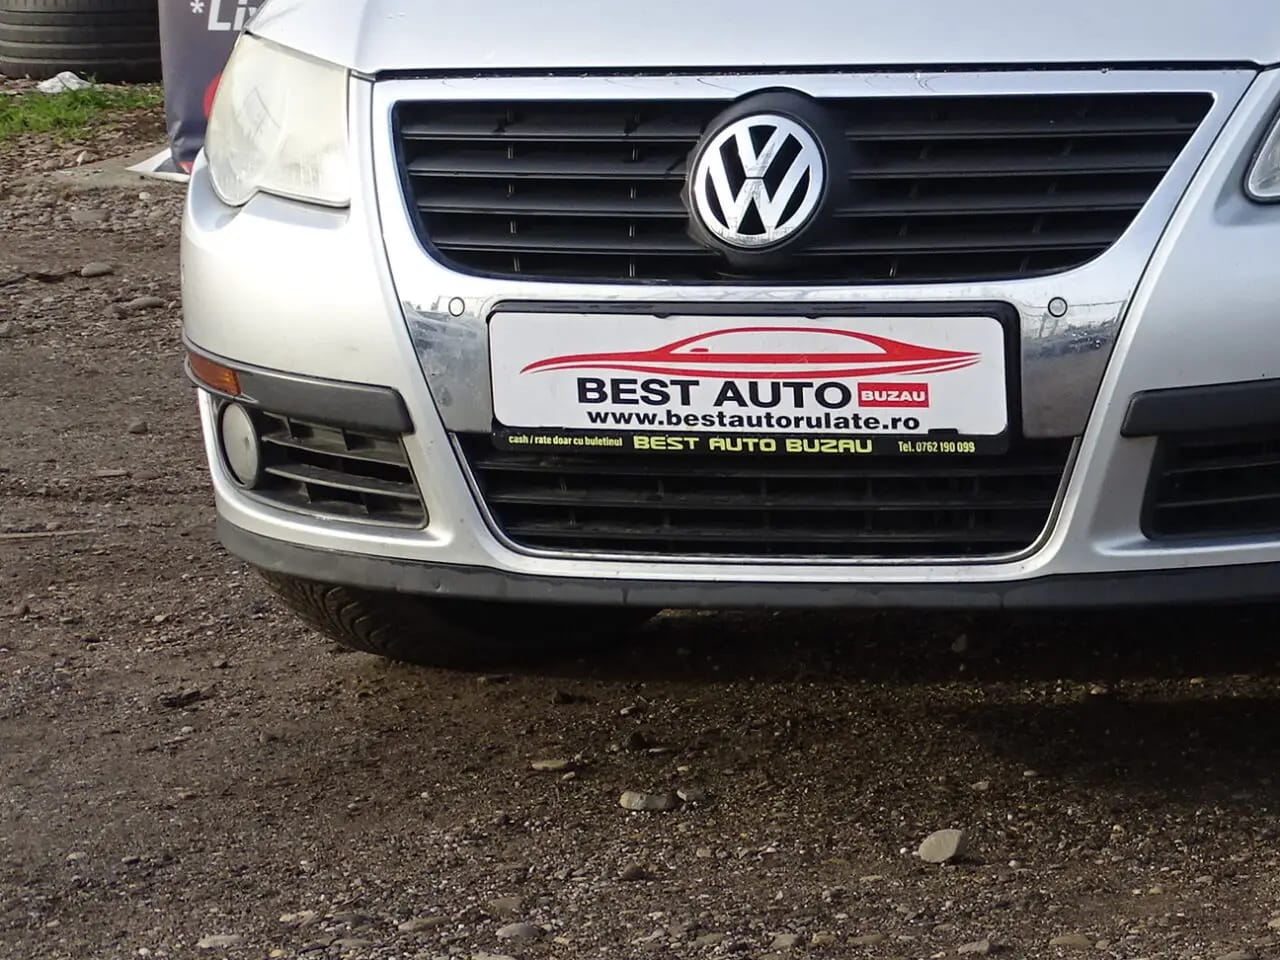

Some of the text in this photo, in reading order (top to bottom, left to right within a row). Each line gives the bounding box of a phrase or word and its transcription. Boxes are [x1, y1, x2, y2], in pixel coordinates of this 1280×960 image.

[576, 377, 926, 409] BEST AUTO BUZAU
[586, 408, 920, 431] www.bestautorulate.ro
[508, 435, 529, 445] cash
[534, 435, 552, 445] rate
[553, 436, 572, 446] doar
[572, 438, 584, 446] cu
[633, 435, 699, 450] BEST
[709, 437, 776, 452] AUTO
[786, 439, 873, 453] BUZAU
[898, 441, 915, 452] Tel.
[916, 441, 938, 453] 0762
[940, 441, 956, 453] 190
[957, 441, 975, 453] 099
